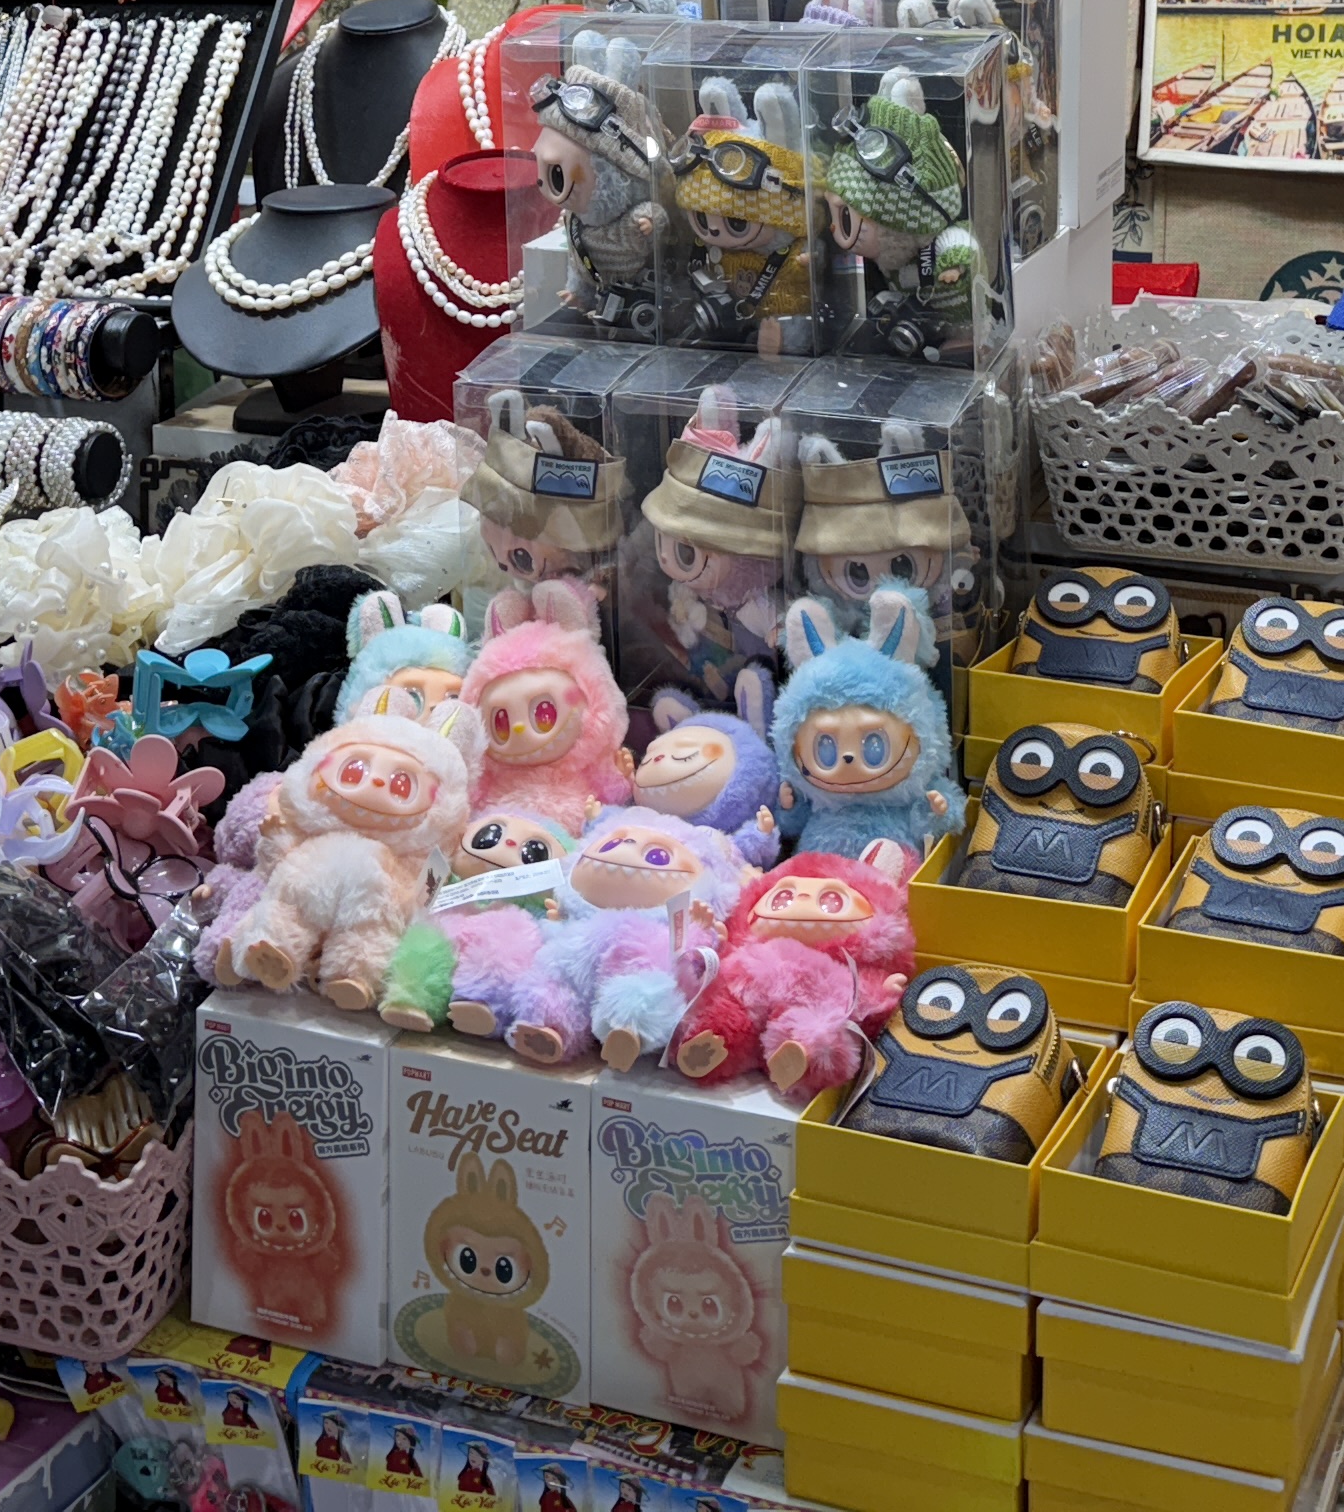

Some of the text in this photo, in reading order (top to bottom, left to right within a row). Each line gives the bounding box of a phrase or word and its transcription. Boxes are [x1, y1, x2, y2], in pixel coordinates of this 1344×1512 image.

[1290, 48, 1319, 60] VIET
[712, 118, 738, 129] MART
[921, 244, 933, 276] SMIL
[541, 460, 592, 473] THE MONSTERS
[712, 458, 726, 468] THE
[886, 459, 936, 472] THE MONSTERS
[199, 1035, 353, 1100] Big into
[220, 1086, 374, 1139] Energy
[407, 1090, 497, 1134] Have
[486, 1109, 569, 1158] Seat
[598, 1115, 772, 1184] Big into
[624, 1168, 790, 1224] Energy
